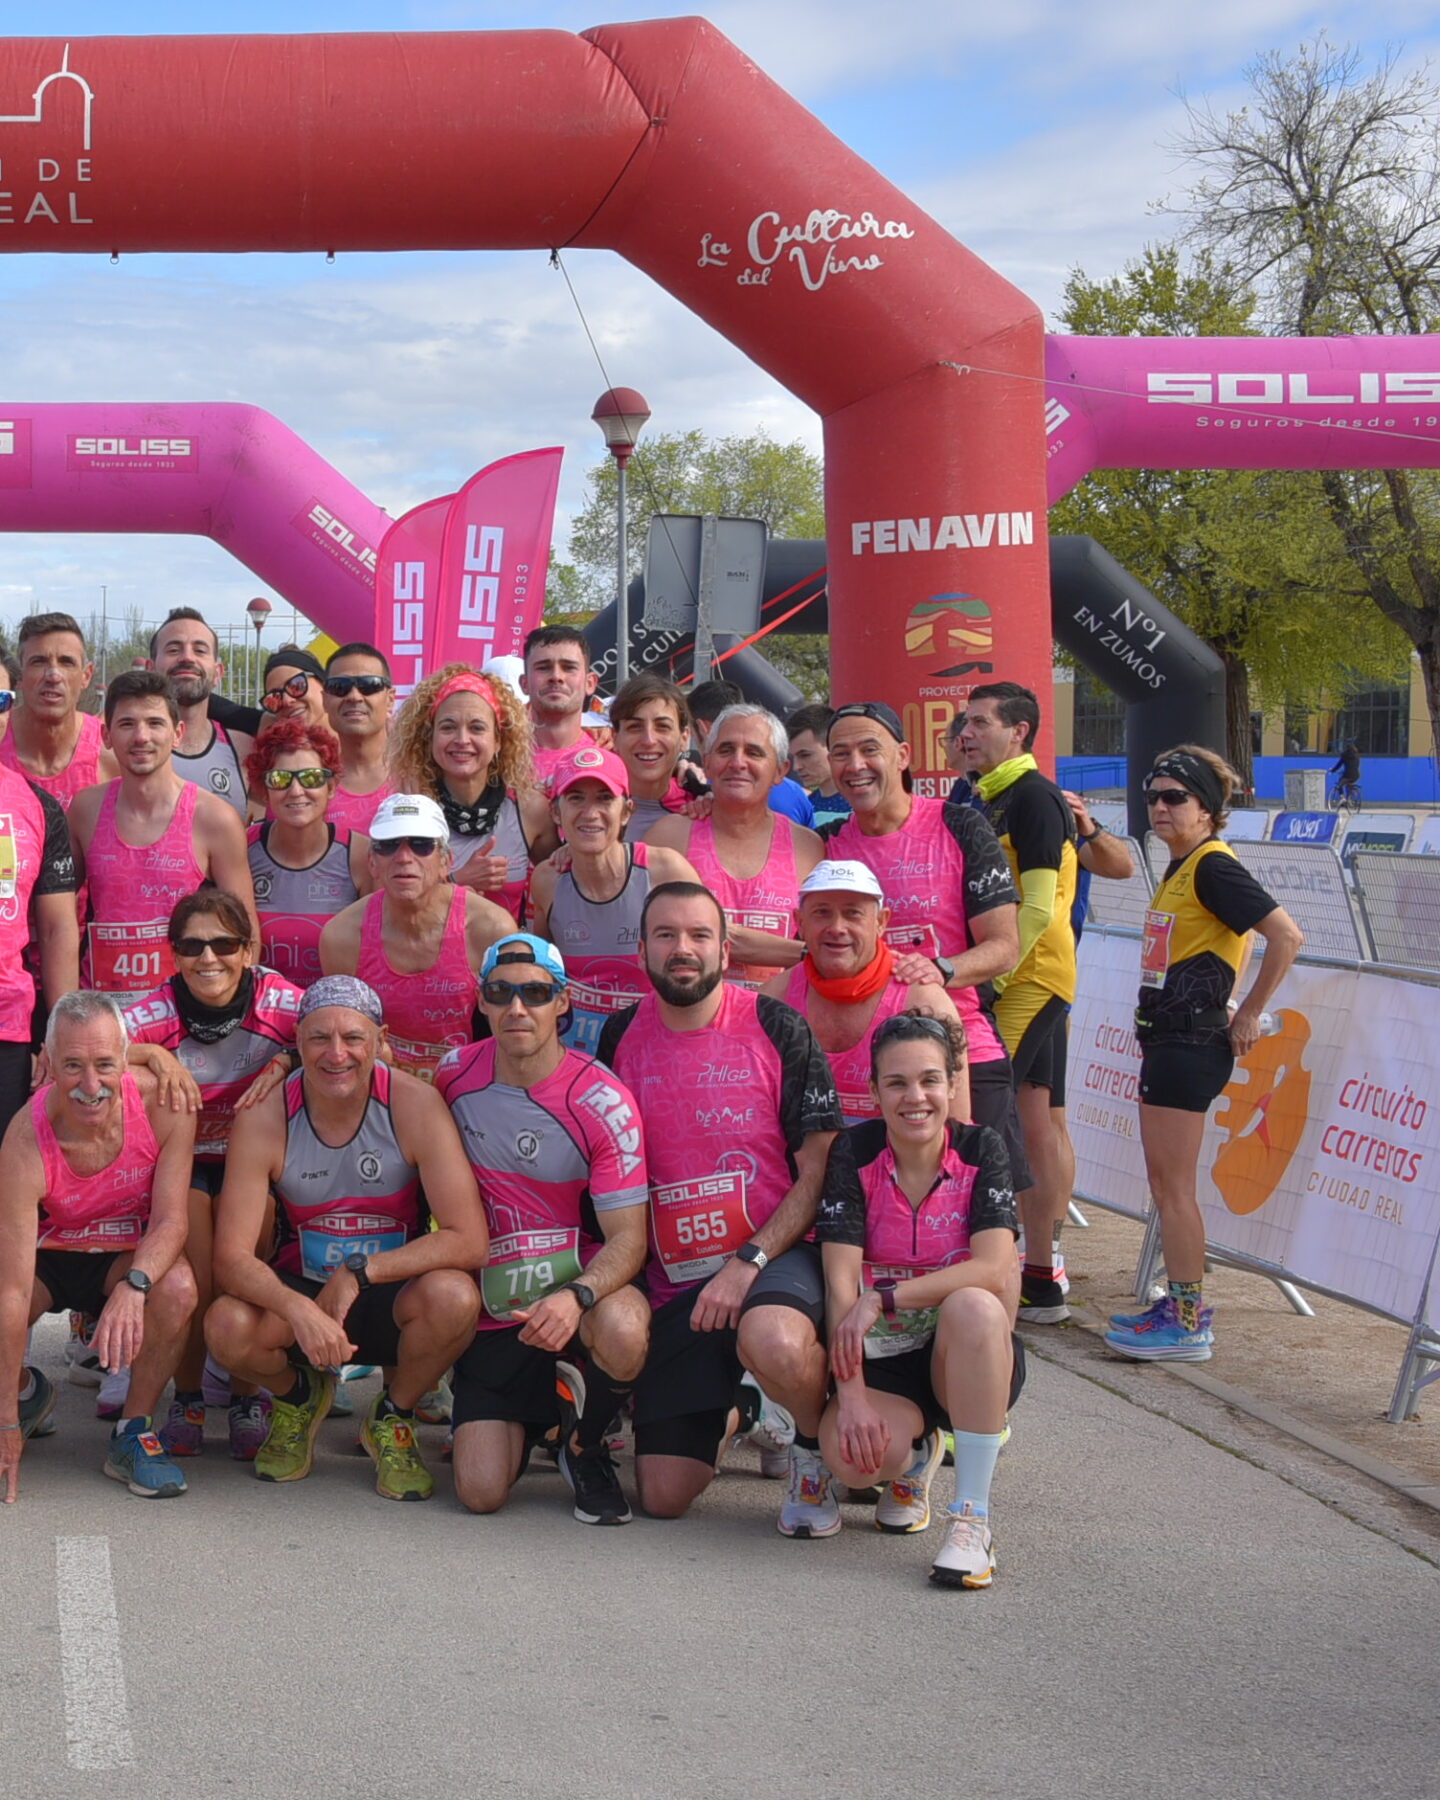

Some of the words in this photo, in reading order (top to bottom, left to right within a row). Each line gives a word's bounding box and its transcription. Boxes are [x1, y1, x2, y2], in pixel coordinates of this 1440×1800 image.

[38, 157, 92, 182] DE
[697, 232, 732, 268] La
[746, 208, 915, 265] Cultura
[736, 266, 772, 286] del
[788, 244, 885, 291] Vino
[1146, 372, 1440, 405] SOLIS
[1195, 415, 1305, 430] Seguros
[1318, 415, 1397, 428] desde
[1412, 416, 1438, 428] 19
[74, 437, 192, 456] SOLISS
[307, 504, 377, 574] SOLIS
[851, 511, 1034, 556] FENAVIN
[513, 563, 529, 604] 1933
[392, 561, 425, 697] LISS
[1072, 605, 1103, 634] EN
[1099, 629, 1167, 690] ZUMOS
[96, 924, 169, 941] SOLISS
[112, 951, 160, 977] 401
[696, 1062, 753, 1084] PHIGP
[1338, 1071, 1428, 1132] circuito
[1075, 1102, 1108, 1129] CIUDAD
[1110, 1111, 1136, 1138] REAL
[1320, 1121, 1424, 1183] carreras
[657, 1178, 736, 1206] SOLISS
[1306, 1170, 1371, 1211] CIUDAD
[1373, 1188, 1405, 1227] REAL
[58, 1221, 135, 1240] SOLISS
[307, 1217, 397, 1231] SOLISS
[676, 1209, 729, 1245] 555
[488, 1233, 569, 1260] SOLISS
[504, 1261, 556, 1297] 779
